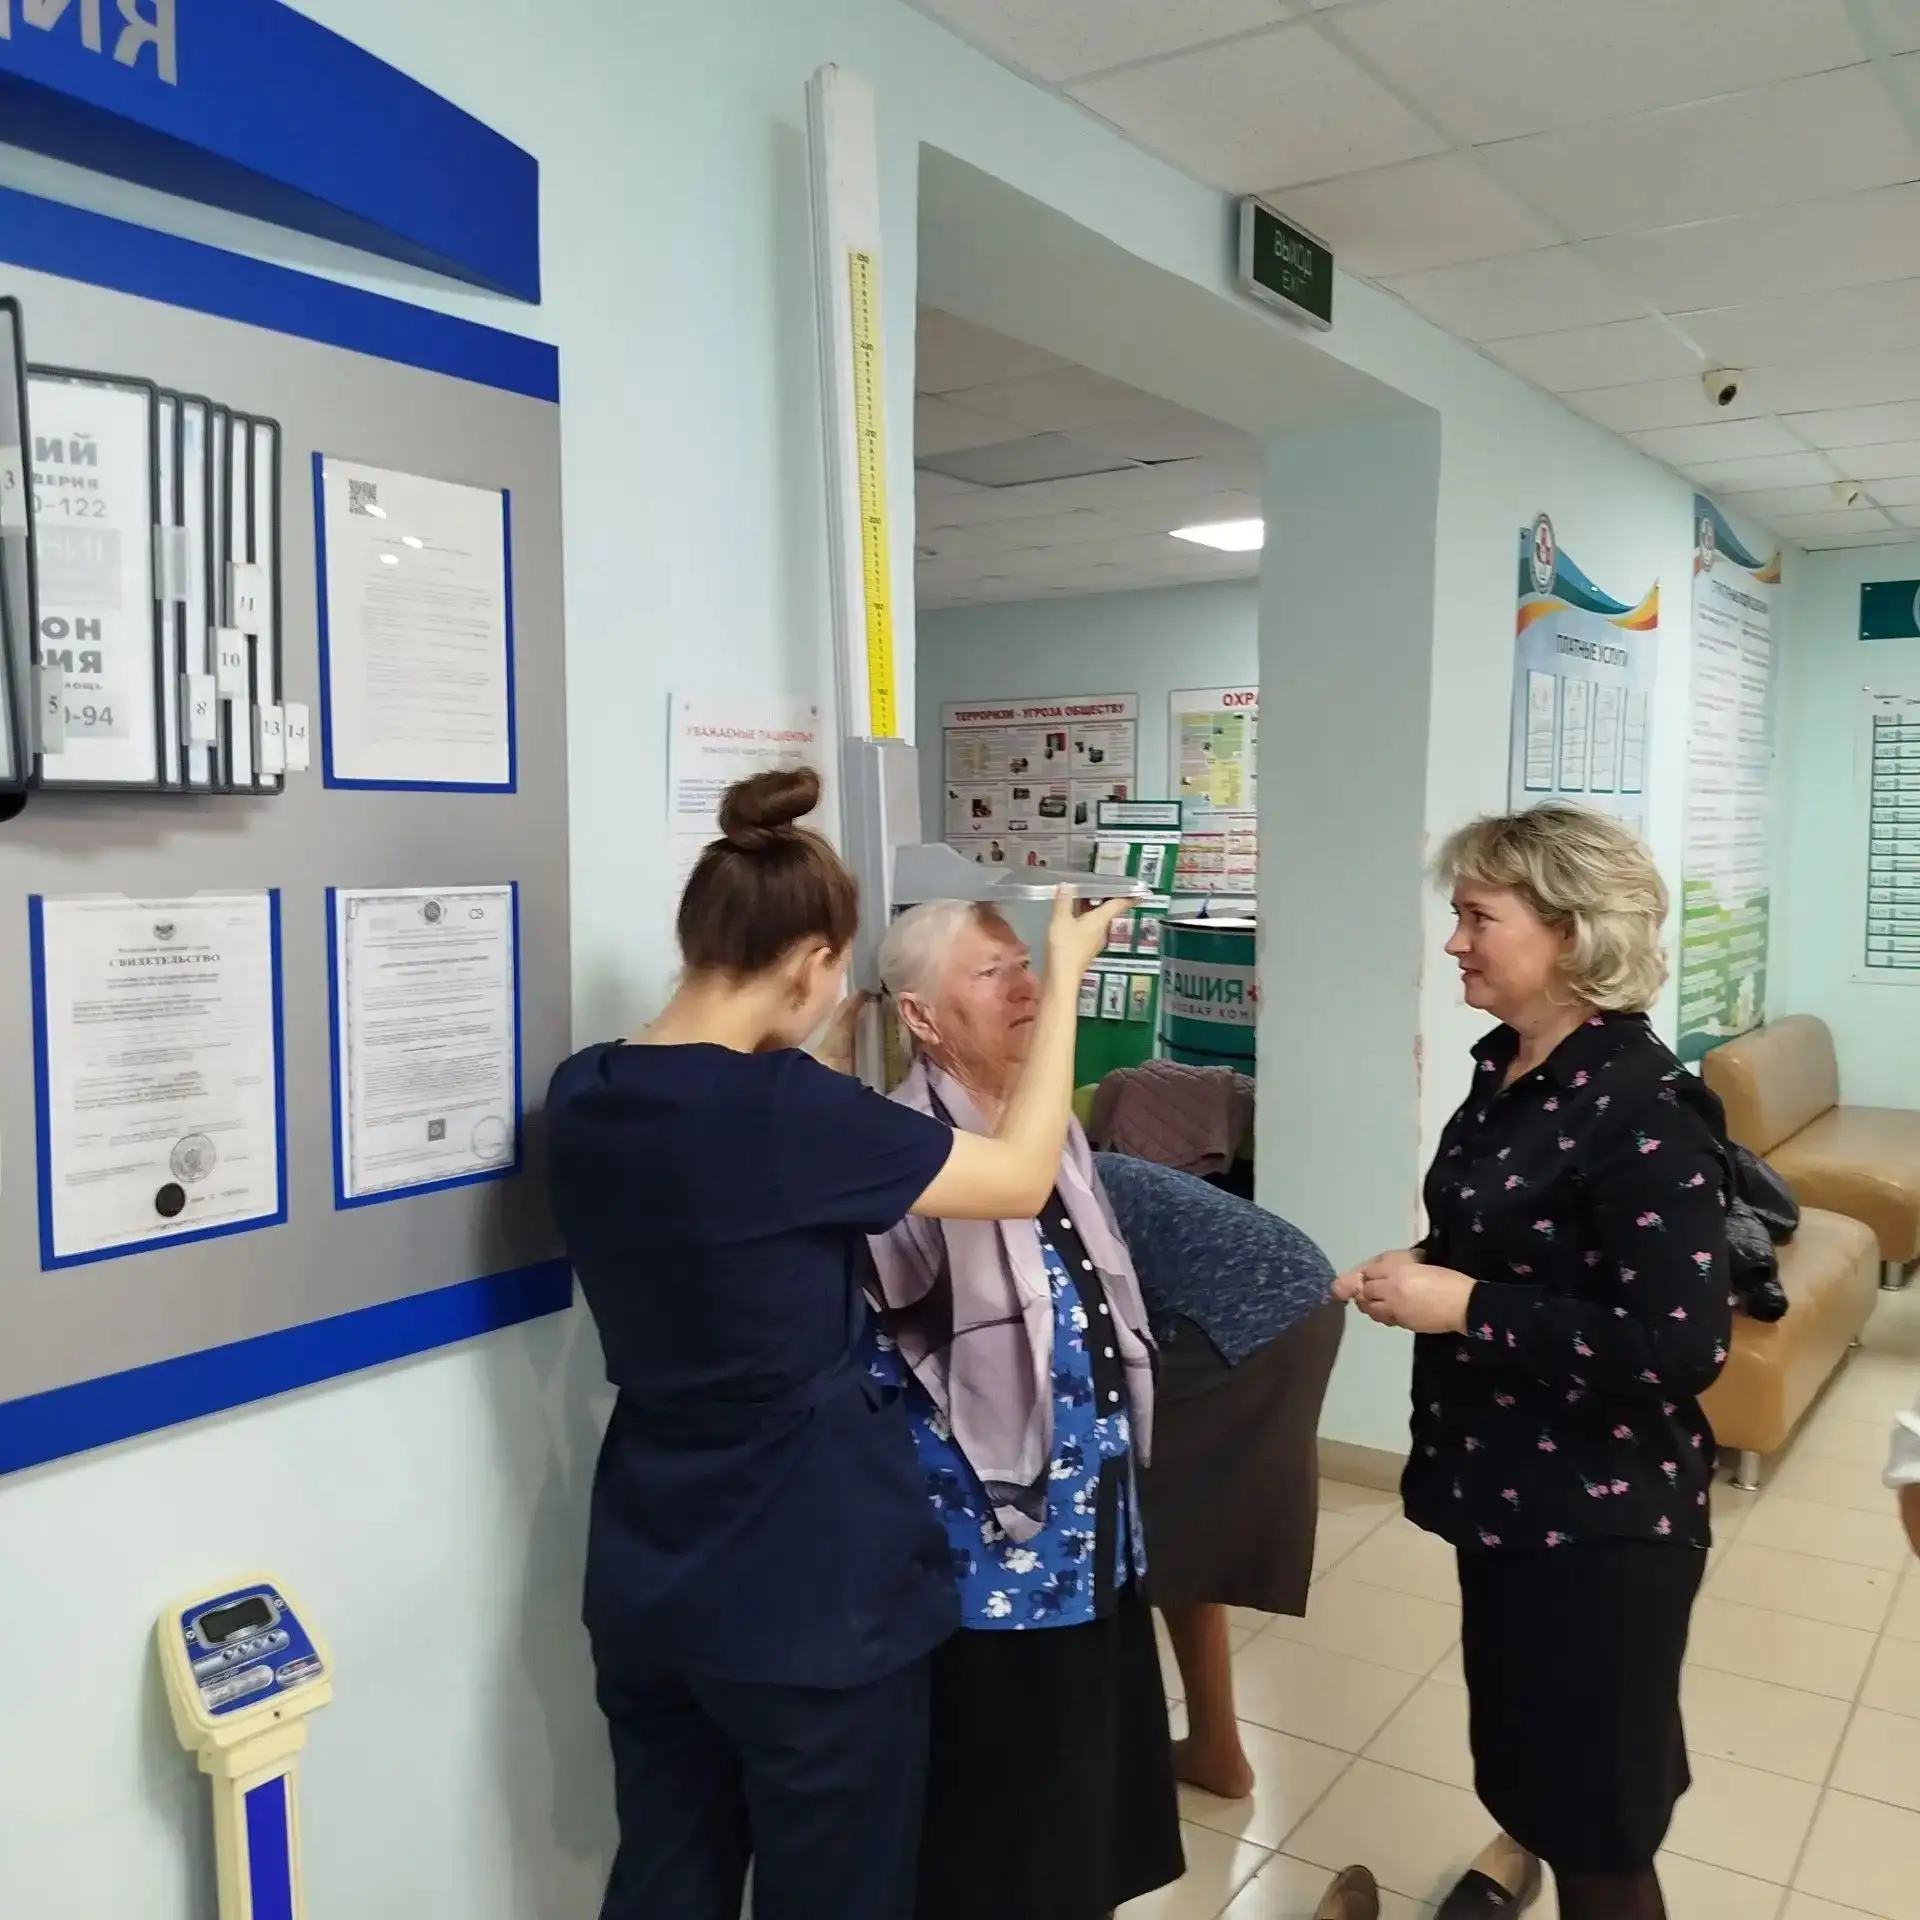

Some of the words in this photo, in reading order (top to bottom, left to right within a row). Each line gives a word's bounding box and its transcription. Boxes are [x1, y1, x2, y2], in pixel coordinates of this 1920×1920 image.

[1274, 229, 1312, 278] ВЫХОД
[35, 432, 98, 466] ИЙ
[4, 470, 16, 490] 3
[32, 471, 99, 489] ВЕРИЯ
[33, 494, 107, 519] 0-122
[239, 596, 256, 612] 11
[41, 616, 102, 641] ОН
[37, 649, 103, 674] ИЯ
[221, 651, 241, 667] 10
[49, 695, 59, 714] 5
[196, 702, 207, 716] 8
[954, 709, 1014, 722] ТЕРРОРИЗМ
[1022, 706, 1063, 719] УГРОЗА
[1064, 703, 1125, 717] ОБЩЕСТВУ
[263, 720, 281, 736] 13
[287, 725, 306, 739] 14
